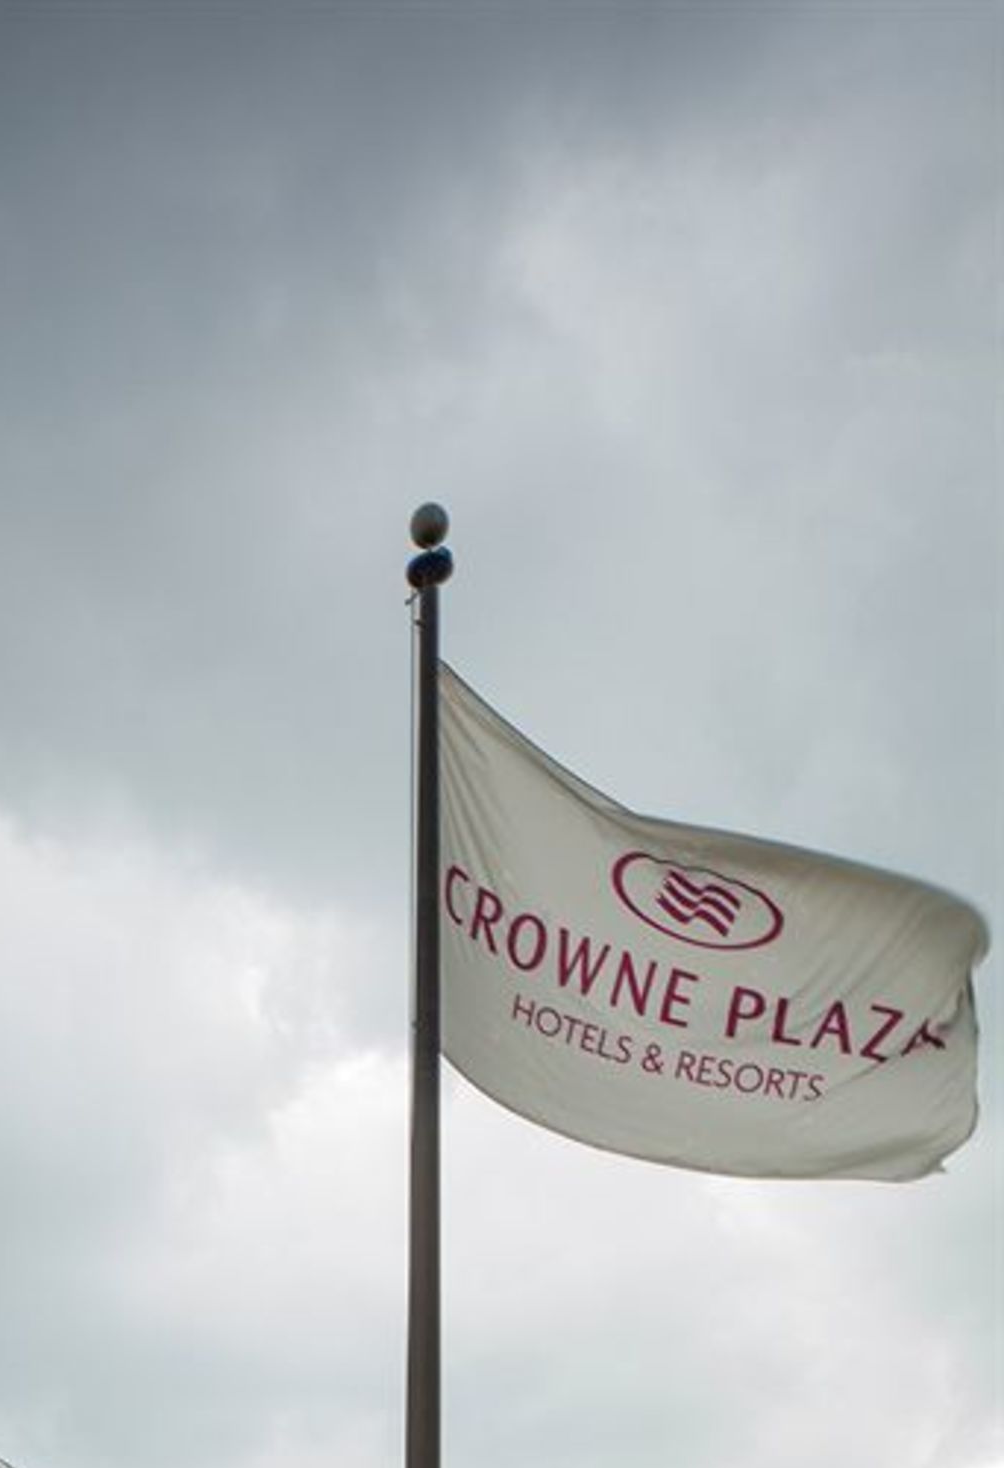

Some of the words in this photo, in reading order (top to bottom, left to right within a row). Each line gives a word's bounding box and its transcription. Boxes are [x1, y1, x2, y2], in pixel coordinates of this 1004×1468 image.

[444, 864, 702, 1029] CROWNE
[725, 985, 947, 1064] PLAZA
[511, 993, 632, 1065] HOTELS
[641, 1042, 665, 1075] &
[675, 1050, 825, 1102] RESORTS
